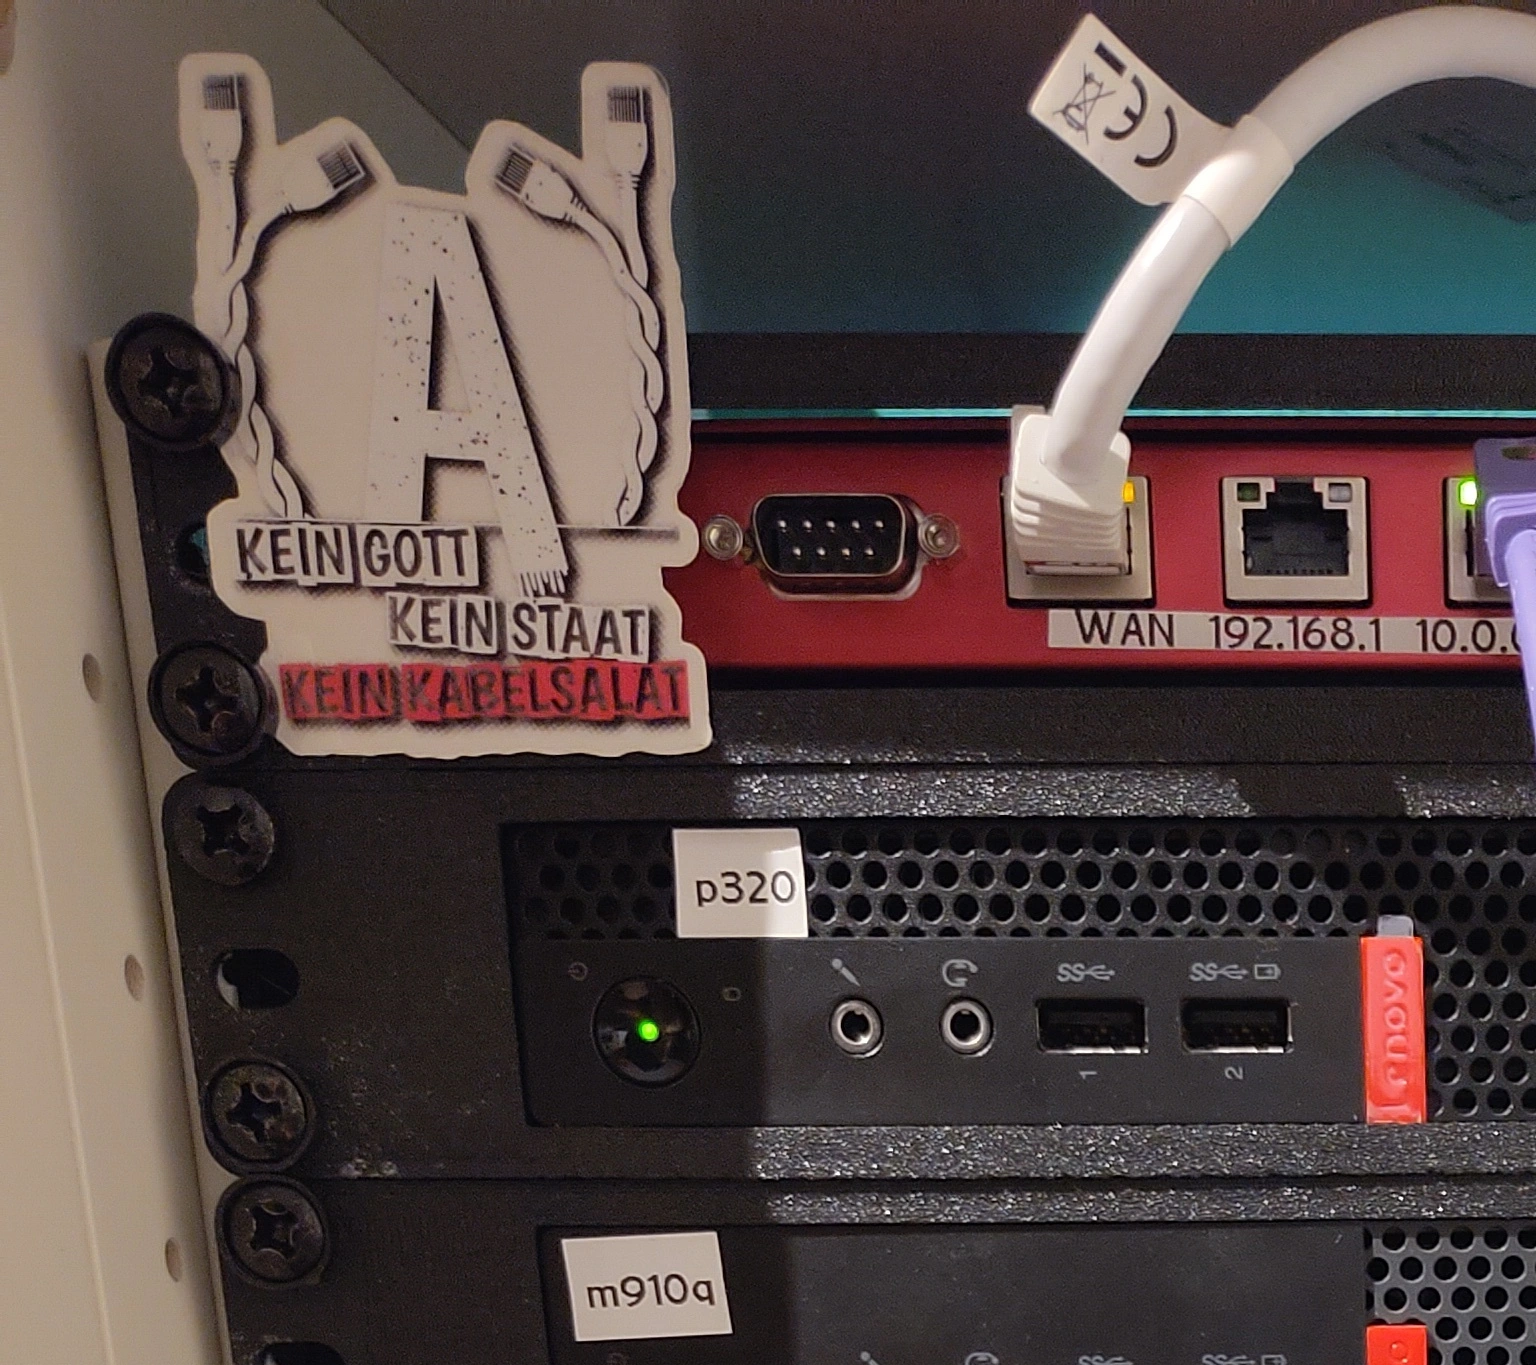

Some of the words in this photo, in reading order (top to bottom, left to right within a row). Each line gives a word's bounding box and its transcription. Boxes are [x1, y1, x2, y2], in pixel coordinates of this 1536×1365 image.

[237, 527, 345, 579] KEIN
[363, 528, 470, 578] GOTT
[389, 596, 494, 648] KEIN
[511, 602, 645, 656] STAAT
[1074, 608, 1175, 649] WAN
[1208, 613, 1382, 653] 192.168.1
[283, 665, 386, 718] KEIN
[404, 662, 687, 719] KABELSALAT
[695, 869, 797, 908] p320
[1078, 1070, 1098, 1080] 1
[1224, 1066, 1244, 1080] 2
[586, 1273, 716, 1309] m910q
